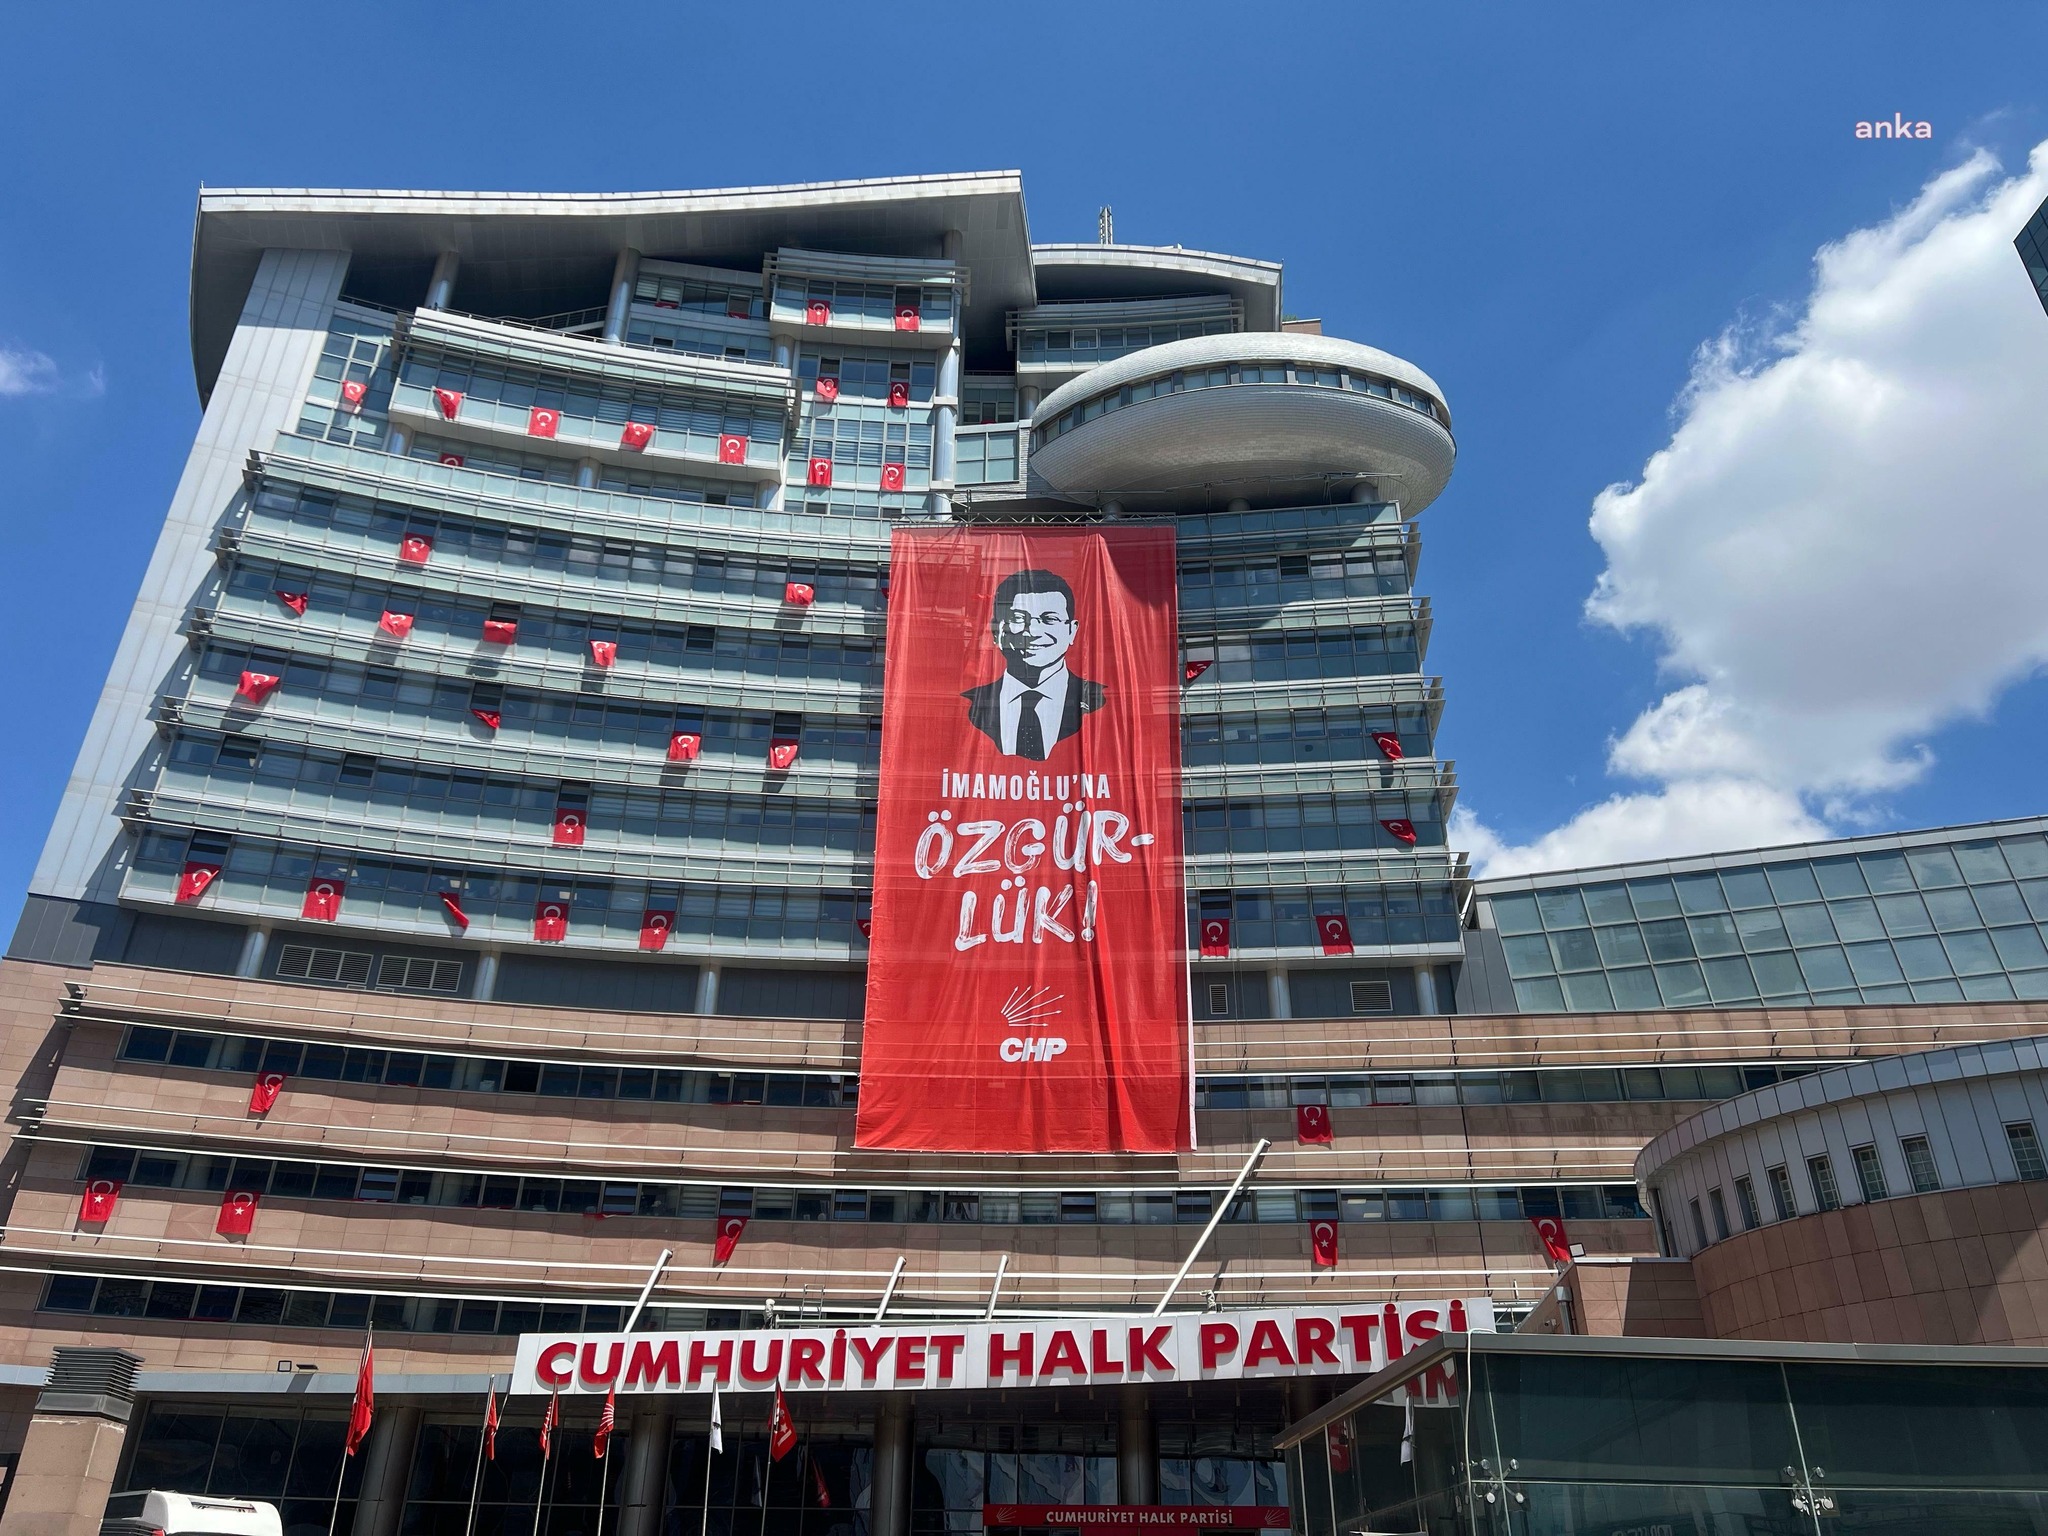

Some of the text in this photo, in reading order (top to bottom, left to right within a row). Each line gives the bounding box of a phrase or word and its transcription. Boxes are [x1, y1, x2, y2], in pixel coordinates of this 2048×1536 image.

[941, 768, 1111, 801] İMAMOĞLU'NA
[914, 801, 1155, 879] ÖZGÜR-
[954, 875, 1098, 951] LÜK!
[999, 1037, 1067, 1062] CHP
[536, 1329, 965, 1386] CUMHURİYET
[989, 1325, 1175, 1378] HALK
[1046, 1508, 1233, 1524] CUMHURİYET HALK PARTİSİ
